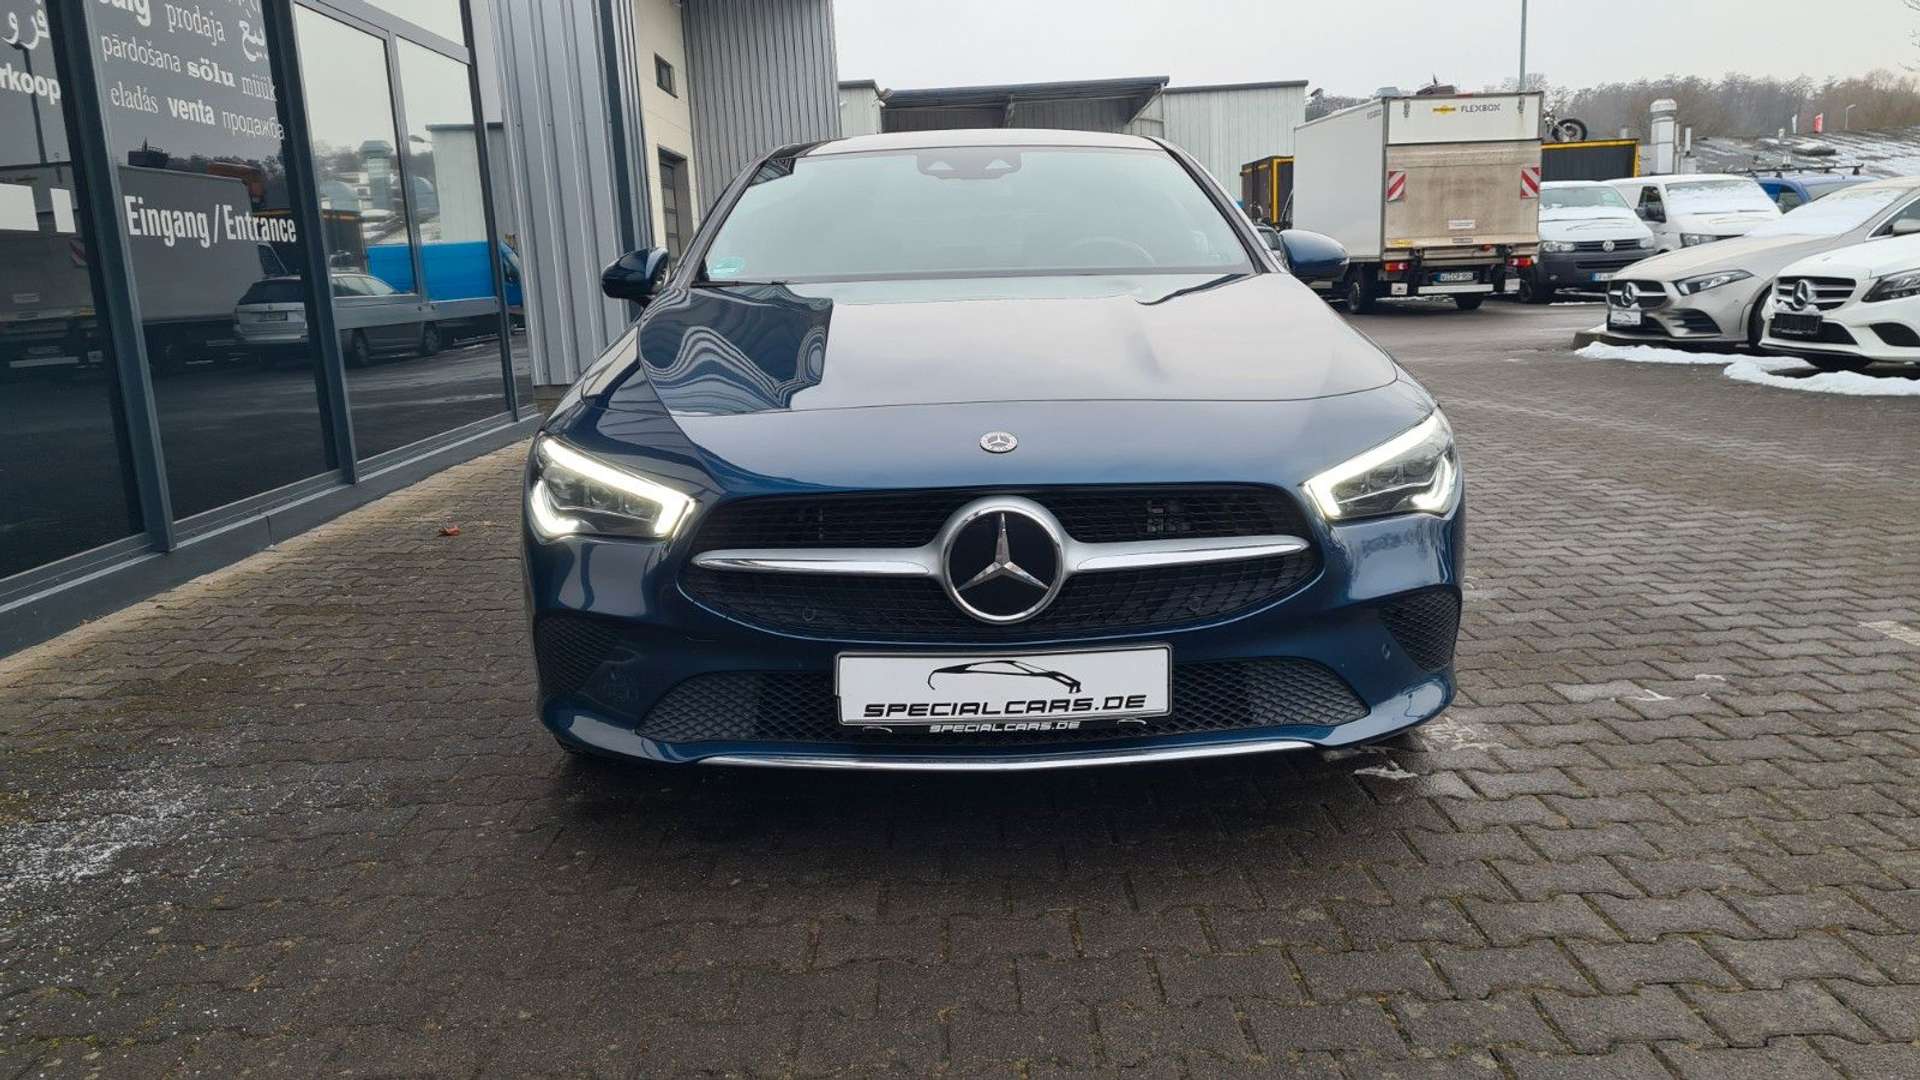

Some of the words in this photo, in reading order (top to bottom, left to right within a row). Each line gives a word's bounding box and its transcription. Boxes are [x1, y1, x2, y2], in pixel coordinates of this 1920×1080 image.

[165, 3, 226, 46] prodaja
[101, 33, 181, 72] pārdošana
[187, 58, 236, 88] sölu
[110, 80, 159, 114] eladás
[168, 97, 216, 126] venta
[124, 195, 210, 248] Eingang
[222, 204, 297, 243] Entrance
[863, 695, 1147, 718] SPECIALCARS.DE
[929, 721, 1081, 733] SPECIALCARS.DE
